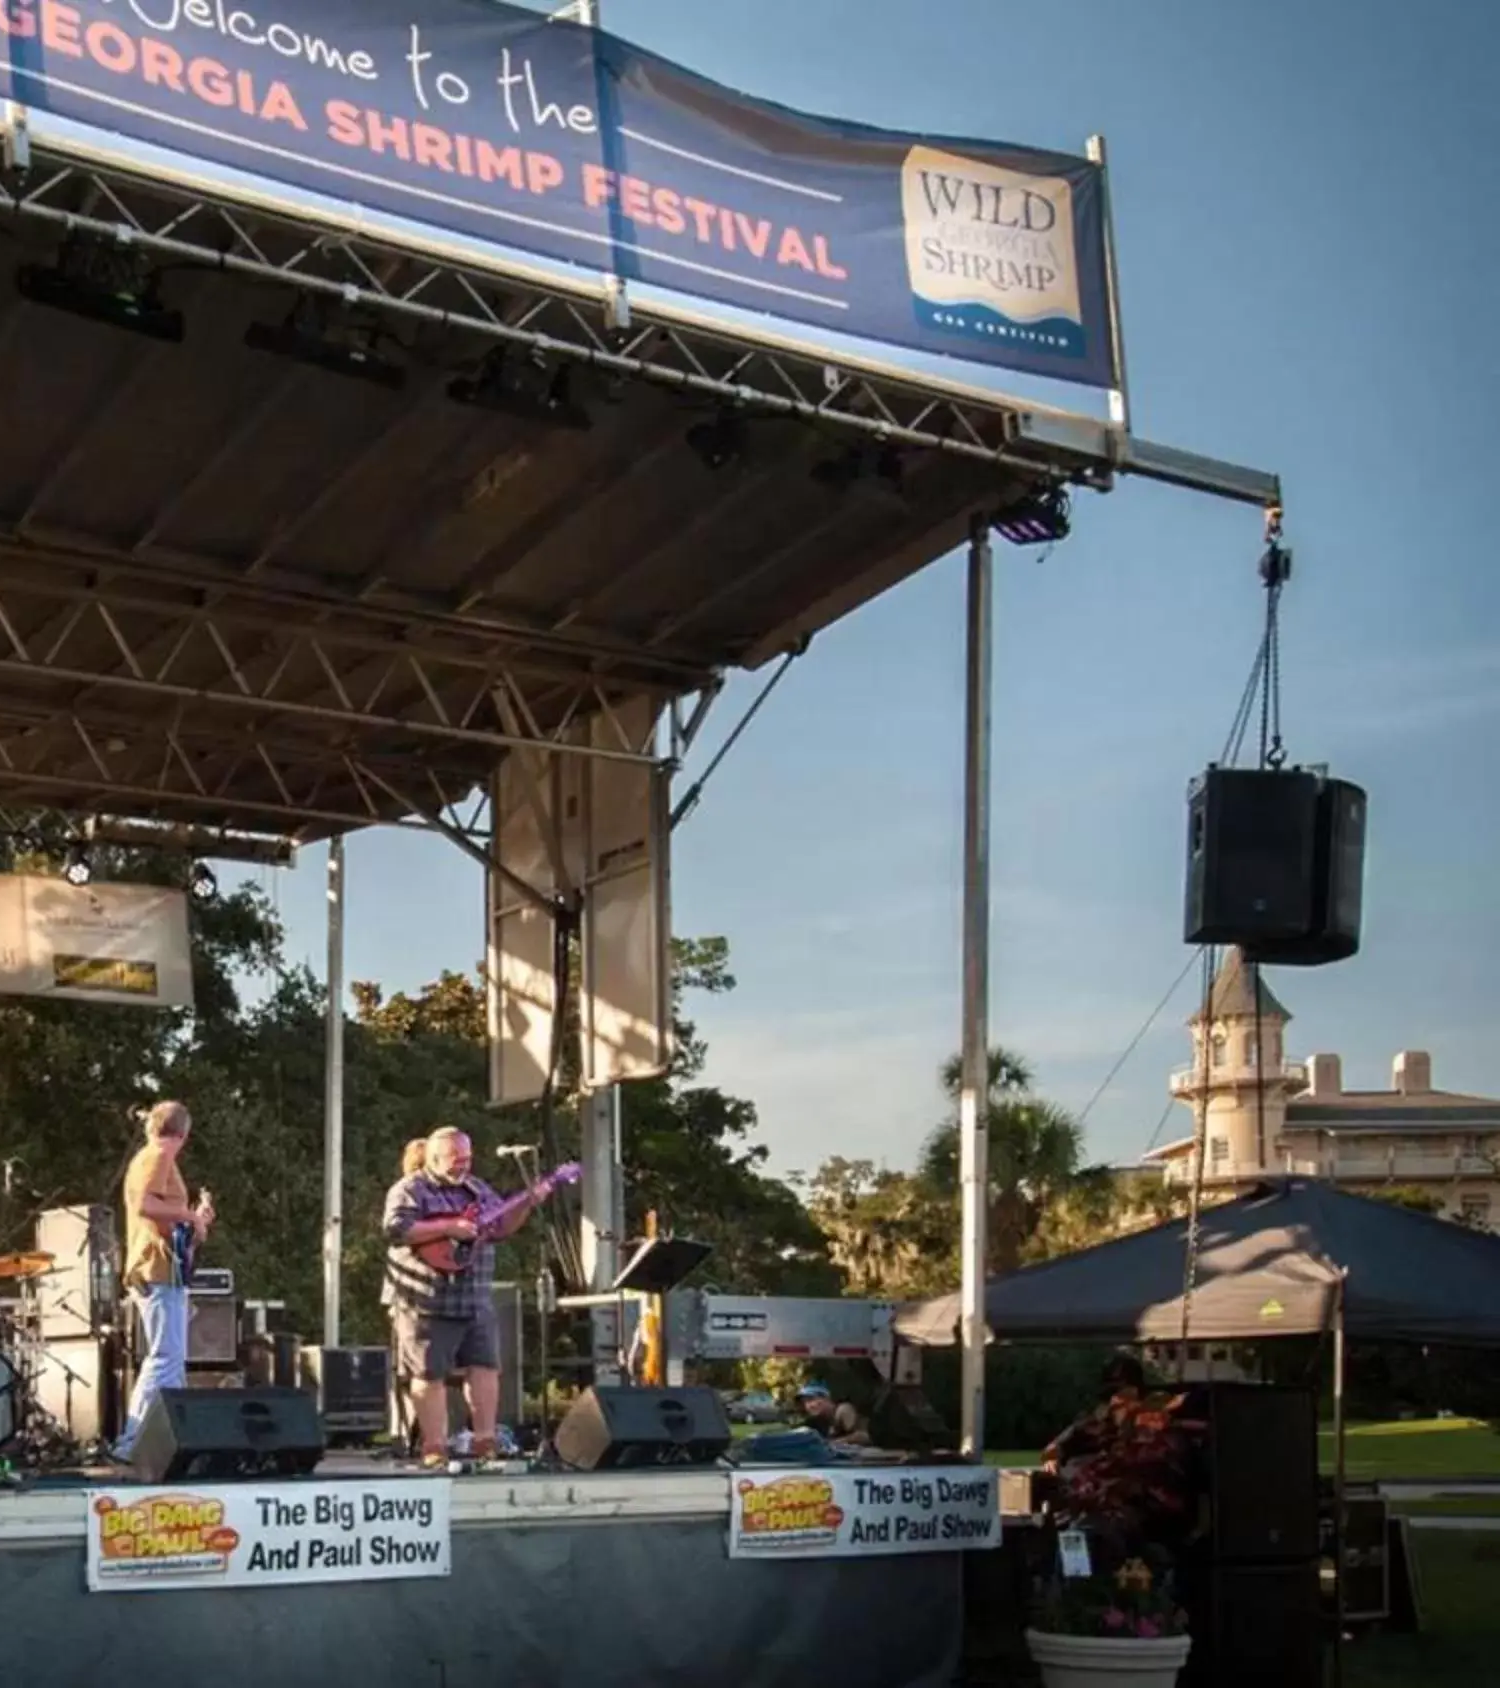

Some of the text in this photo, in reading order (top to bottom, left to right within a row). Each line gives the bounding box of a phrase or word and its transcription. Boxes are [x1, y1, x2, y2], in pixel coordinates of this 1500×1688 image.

[407, 24, 469, 109] to
[498, 47, 597, 133] the
[325, 98, 564, 195] SHRIMP
[580, 163, 849, 281] FESTIVAL
[918, 170, 1056, 232] WILD
[922, 238, 1056, 292] SHRIMP
[854, 1476, 989, 1509] The Big Dawg
[102, 1501, 224, 1538] BIG DAWG
[255, 1493, 433, 1531] The Big Dawg
[850, 1513, 992, 1545] And Paul Show
[136, 1530, 208, 1557] PAUL
[247, 1542, 299, 1572] And
[307, 1539, 362, 1569] Paul
[369, 1536, 441, 1566] Show
